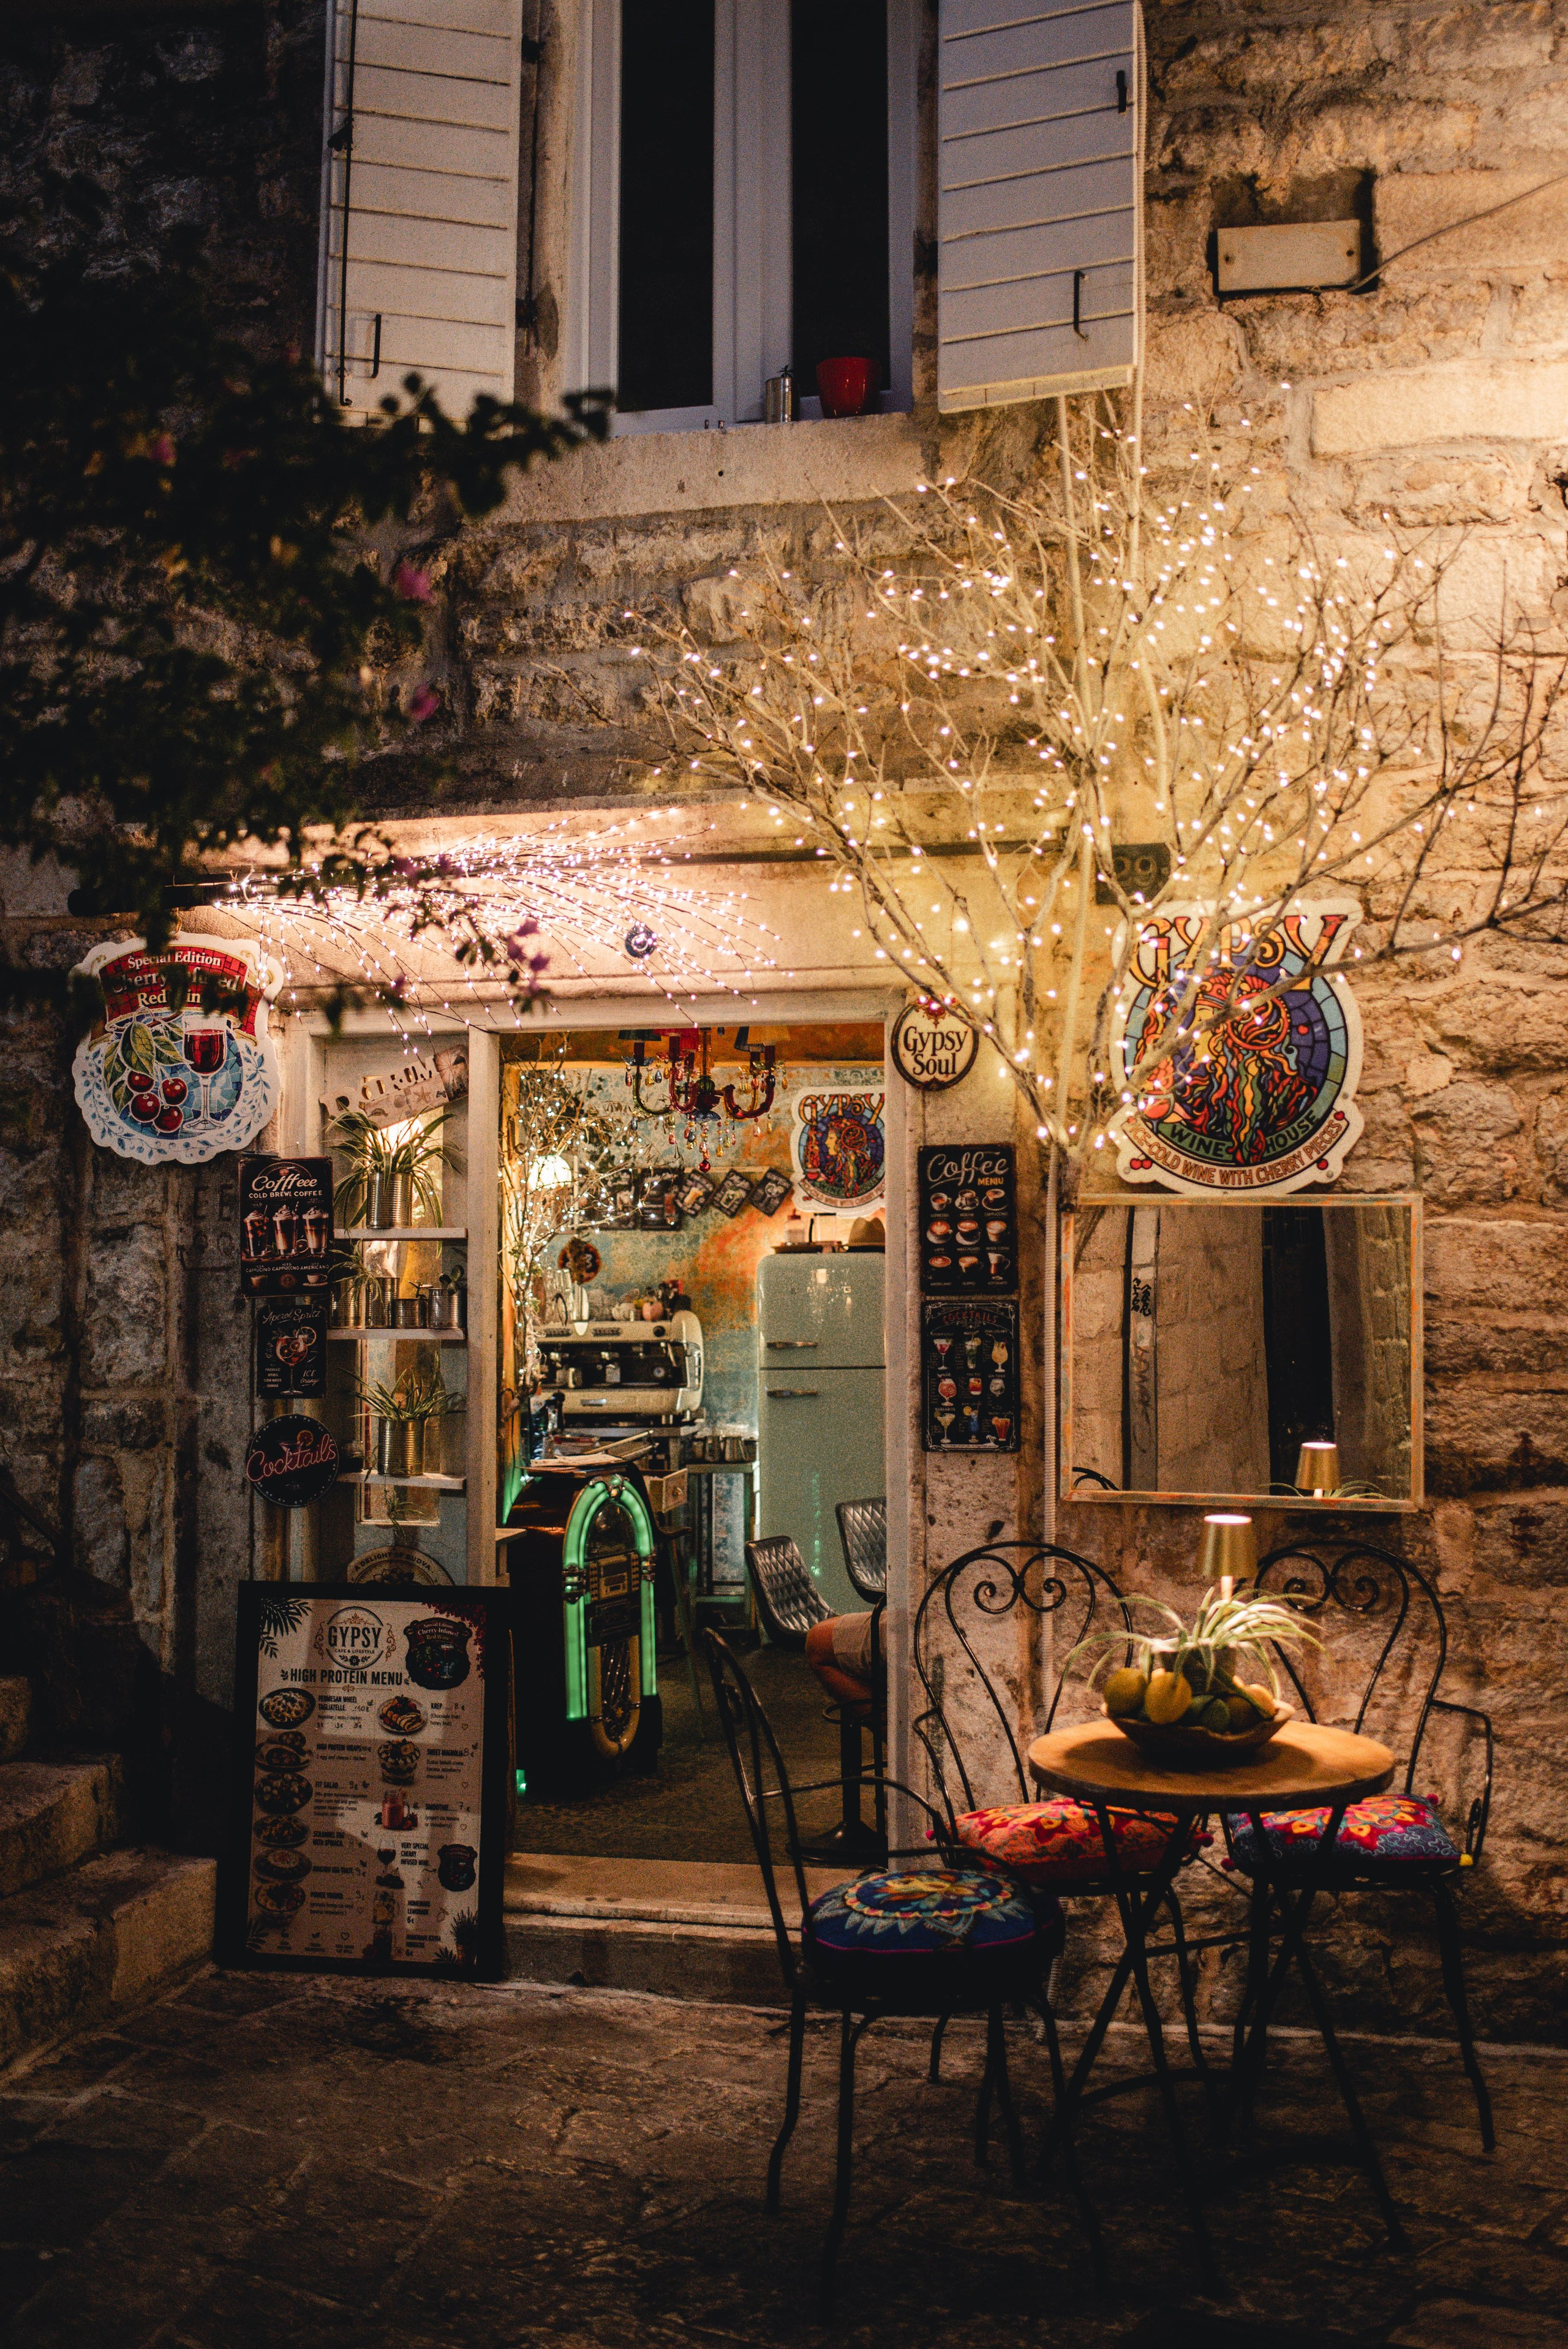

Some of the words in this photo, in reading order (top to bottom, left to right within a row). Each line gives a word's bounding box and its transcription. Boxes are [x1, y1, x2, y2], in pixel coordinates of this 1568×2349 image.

[128, 956, 172, 970] Special
[175, 951, 222, 966] Edition
[1129, 914, 1348, 991] GYPSY
[138, 990, 168, 1005] Red
[903, 1026, 968, 1057] Gypsy
[913, 1052, 956, 1076] Soul
[797, 1092, 885, 1126] GYPSY
[1171, 1123, 1231, 1158] WINE
[1264, 1109, 1321, 1154] HOUSE
[1129, 1124, 1181, 1169] ICE-COLD
[1180, 1164, 1216, 1184] WINE
[1219, 1169, 1253, 1185] WITH
[1255, 1154, 1306, 1183] CHERRY
[1305, 1119, 1343, 1160] PIECES
[927, 1152, 1010, 1187] Coffee
[942, 1310, 998, 1324] COCKTAILS
[303, 1369, 317, 1378] ICE
[246, 1433, 336, 1482] Cocktails
[360, 1552, 393, 1566] DELIGHT
[328, 1626, 382, 1648] GYPSY
[290, 1668, 317, 1683] HIGH
[320, 1670, 368, 1684] PROTEIN
[371, 1671, 403, 1685] MENU
